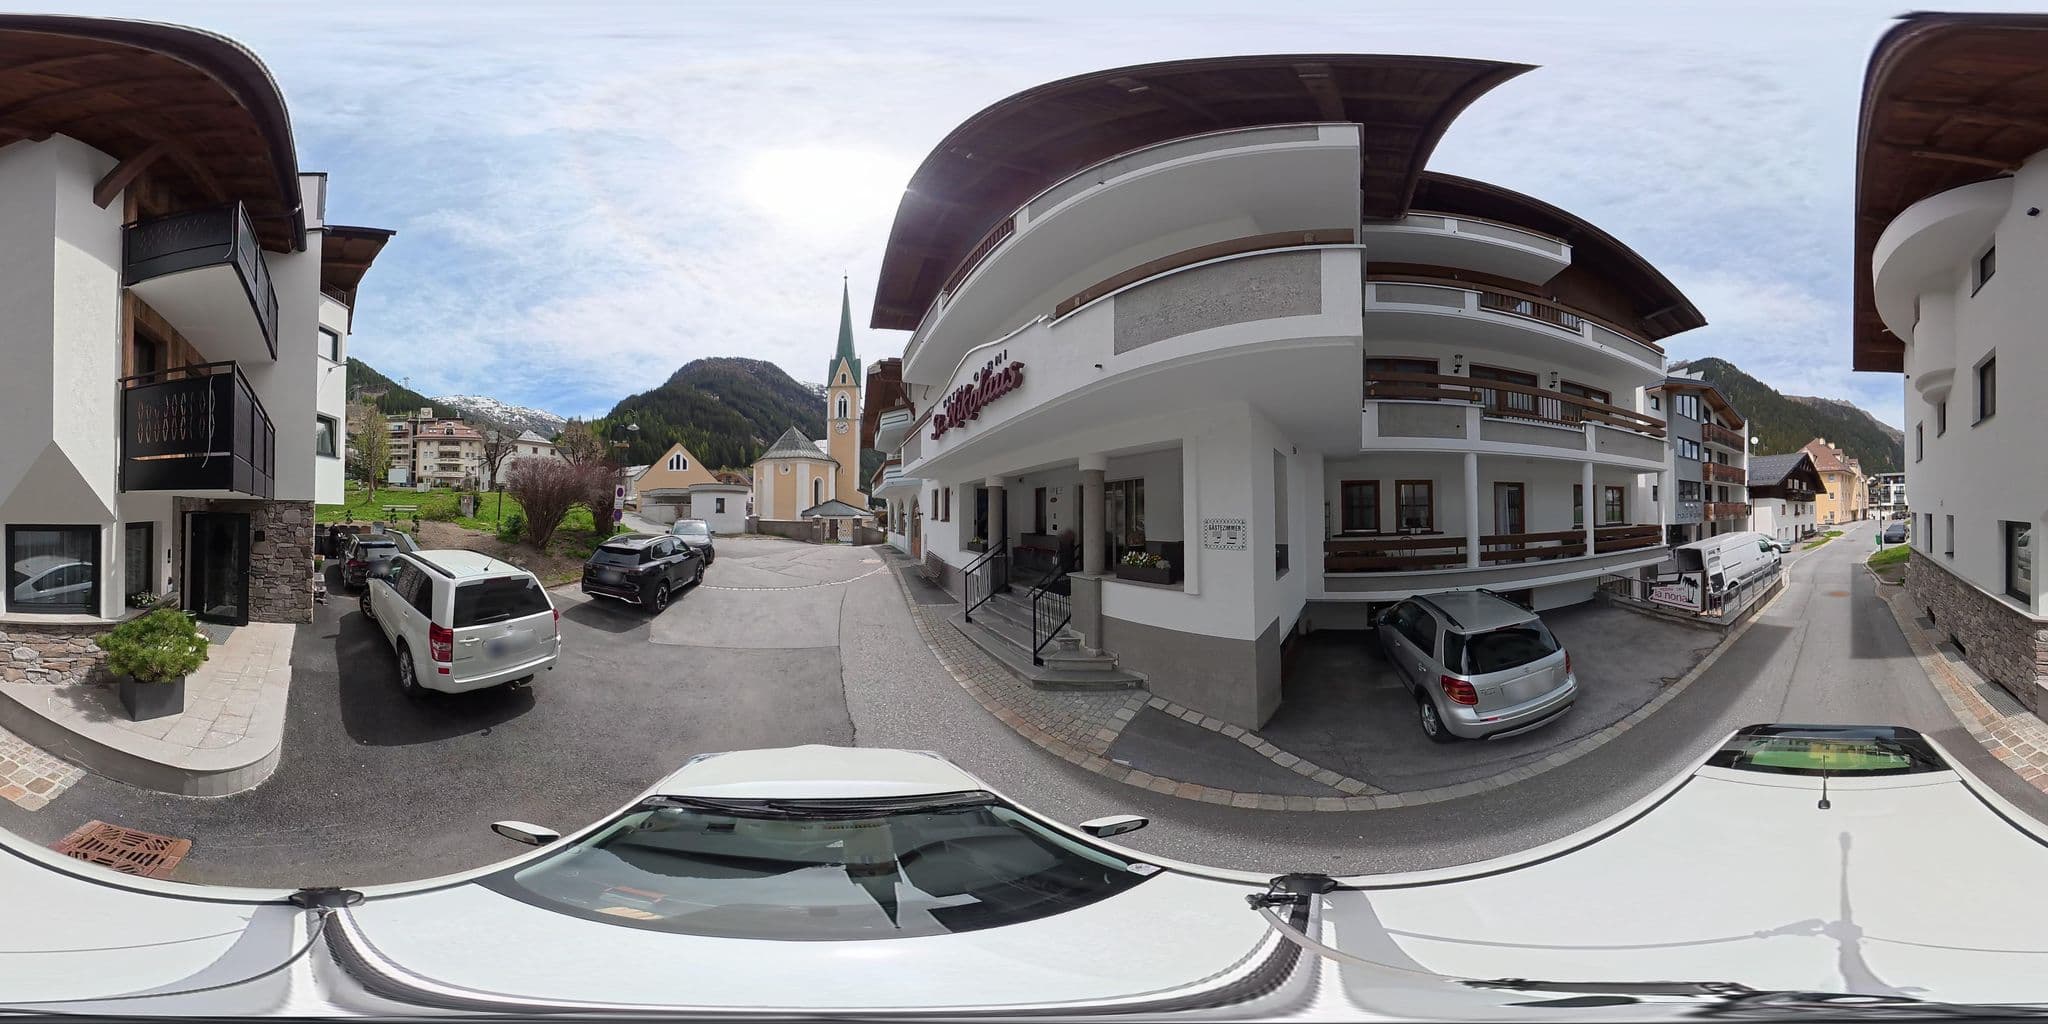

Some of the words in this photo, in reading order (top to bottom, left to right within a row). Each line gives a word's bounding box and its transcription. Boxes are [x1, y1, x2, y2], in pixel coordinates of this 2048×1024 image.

[943, 385, 964, 408] HOTL
[974, 349, 1008, 382] GRNI
[946, 361, 1025, 429] Nikolaus
